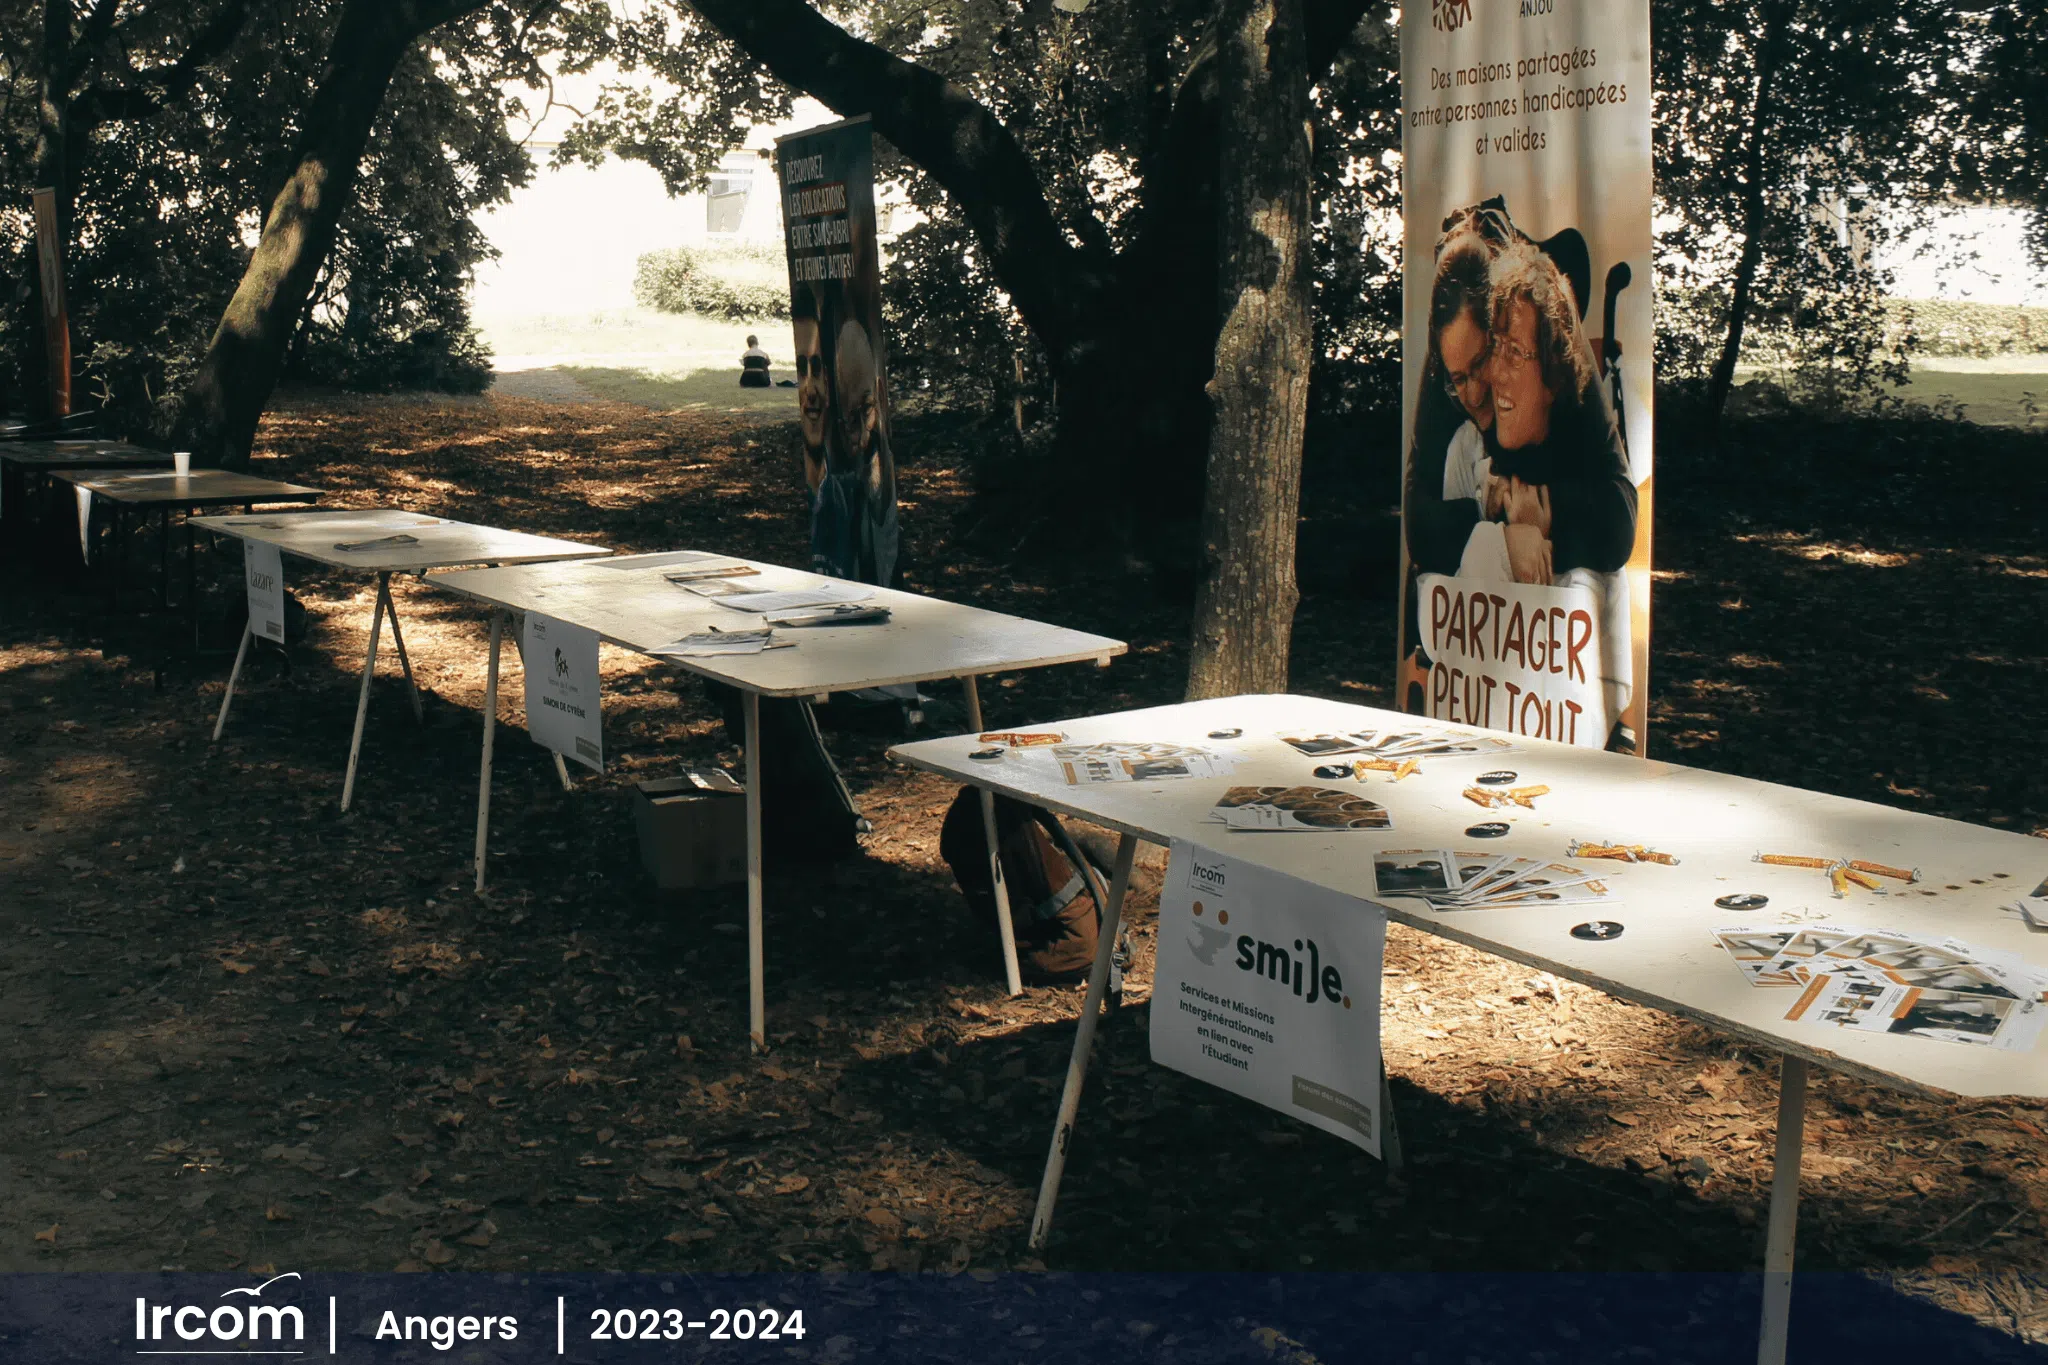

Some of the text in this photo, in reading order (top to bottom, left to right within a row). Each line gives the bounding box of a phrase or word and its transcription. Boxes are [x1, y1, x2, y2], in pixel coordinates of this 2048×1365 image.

[1519, 0, 1553, 18] ANJOU
[1431, 47, 1596, 91] Des maisons partagées
[1411, 82, 1627, 128] entre personnes handicapées
[1476, 126, 1546, 155] et valides
[786, 154, 824, 185] DÉCOUVREZ
[789, 184, 846, 217] LES COLOCATIONS
[792, 224, 813, 249] ENTRE
[1432, 585, 1592, 684] PARTAGER
[1433, 661, 1583, 745] PEUT TOUT
[1193, 863, 1225, 885] Ircom
[1180, 981, 1275, 1025] Services et Missions
[1179, 999, 1274, 1044] Intergénérationnels
[1197, 1025, 1254, 1055] en lien avec
